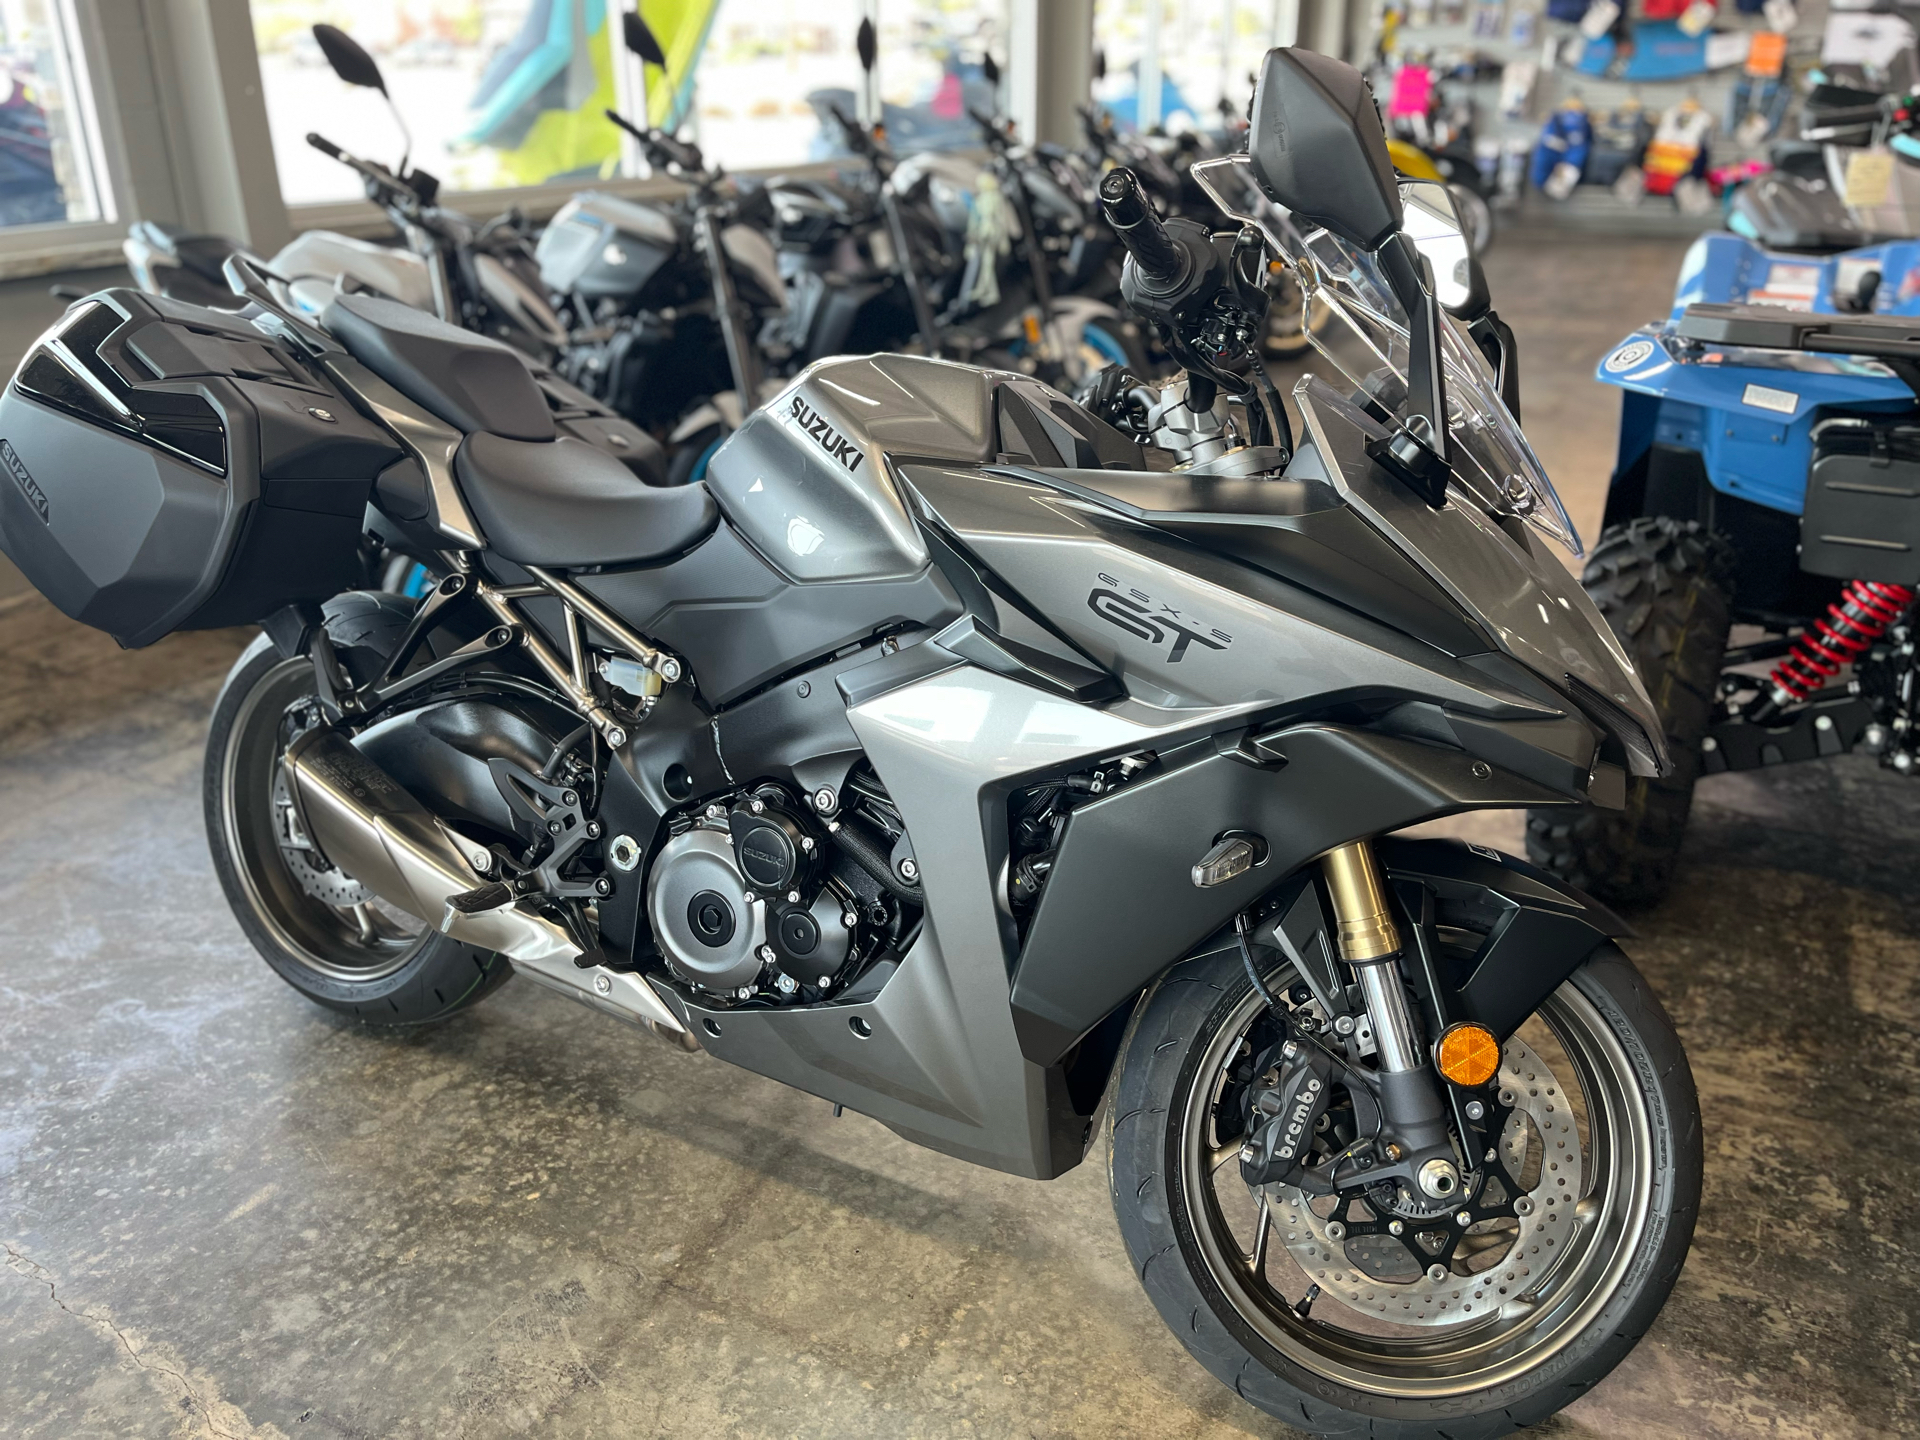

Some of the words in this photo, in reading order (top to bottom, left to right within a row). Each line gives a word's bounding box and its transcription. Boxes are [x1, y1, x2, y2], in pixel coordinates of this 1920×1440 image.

[792, 396, 865, 473] SUZUKI
[2, 443, 48, 514] SUZUKI
[743, 847, 785, 867] SUZUKI
[1274, 1078, 1321, 1159] brembo
